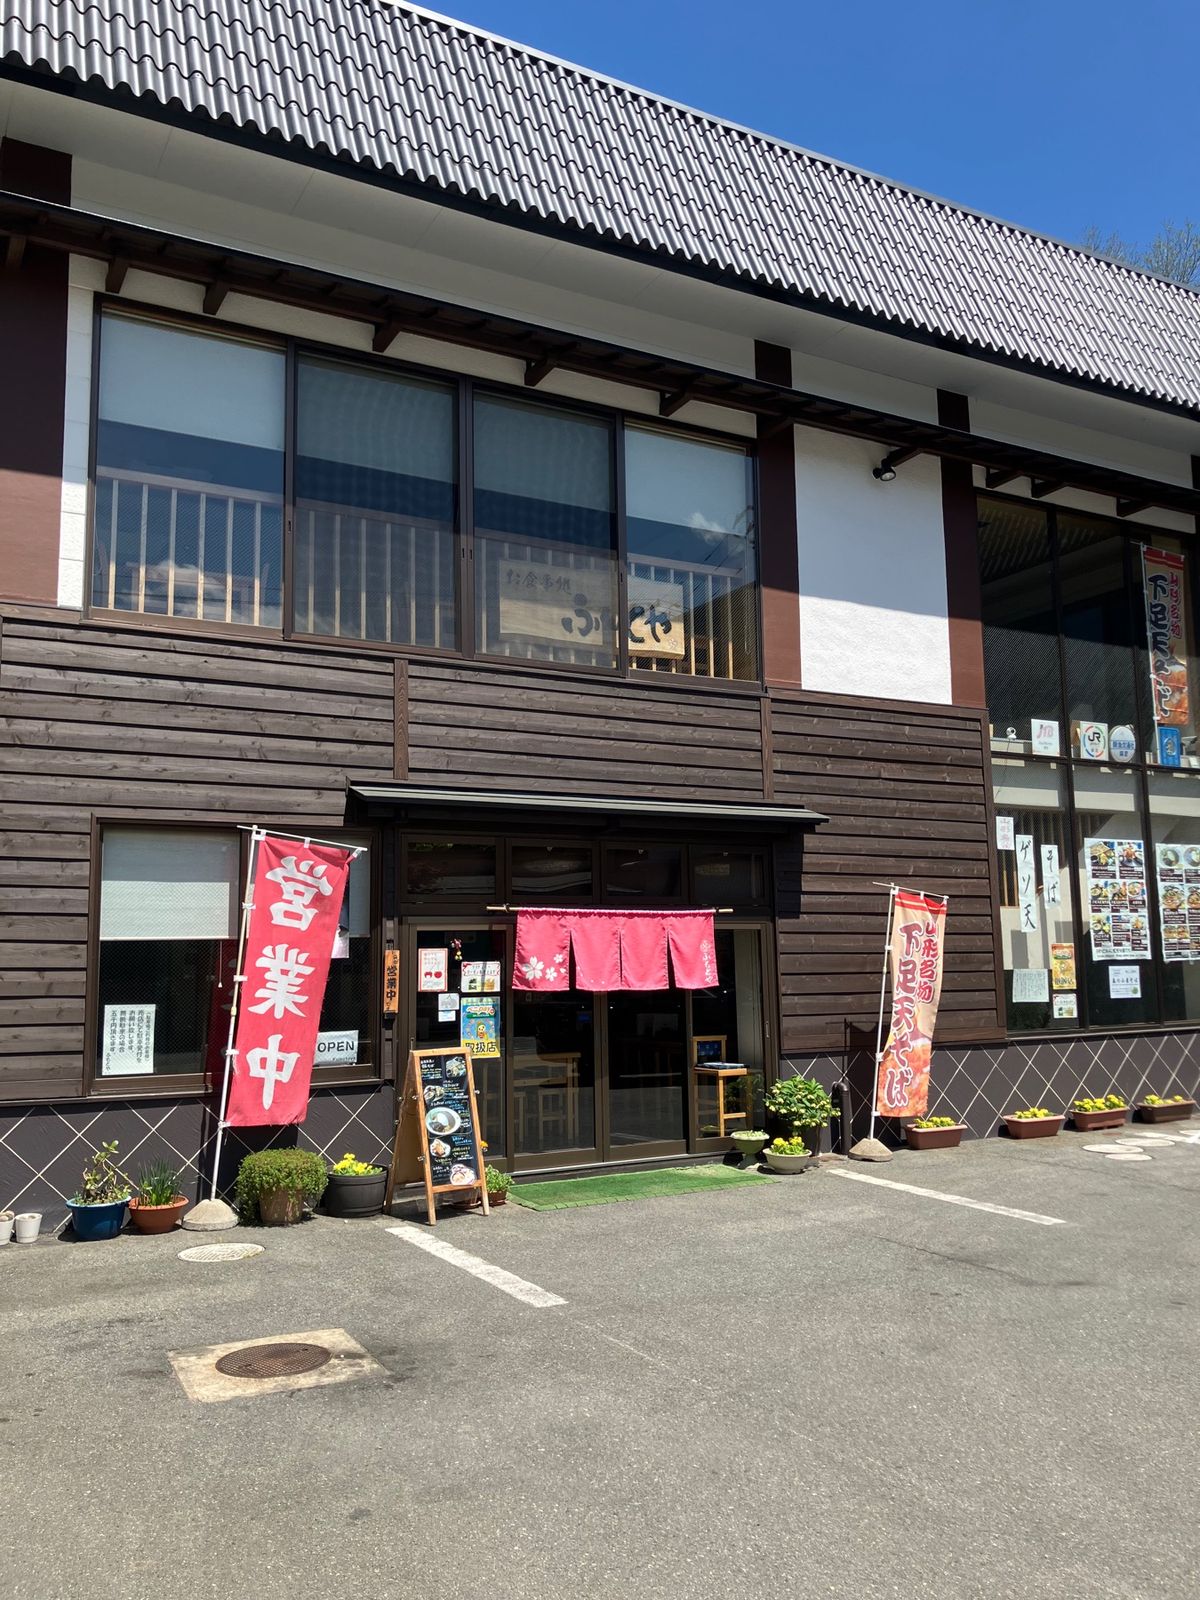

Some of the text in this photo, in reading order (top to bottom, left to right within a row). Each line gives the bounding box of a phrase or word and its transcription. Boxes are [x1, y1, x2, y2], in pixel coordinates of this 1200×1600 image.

[1088, 731, 1101, 743] JR
[1020, 839, 1036, 930] ゲソ天
[1046, 849, 1058, 904] そば
[247, 855, 333, 1111] 営業中
[917, 921, 938, 1003] 山形名物
[317, 1040, 355, 1053] OPEN
[884, 923, 922, 1107] 下足天そば
